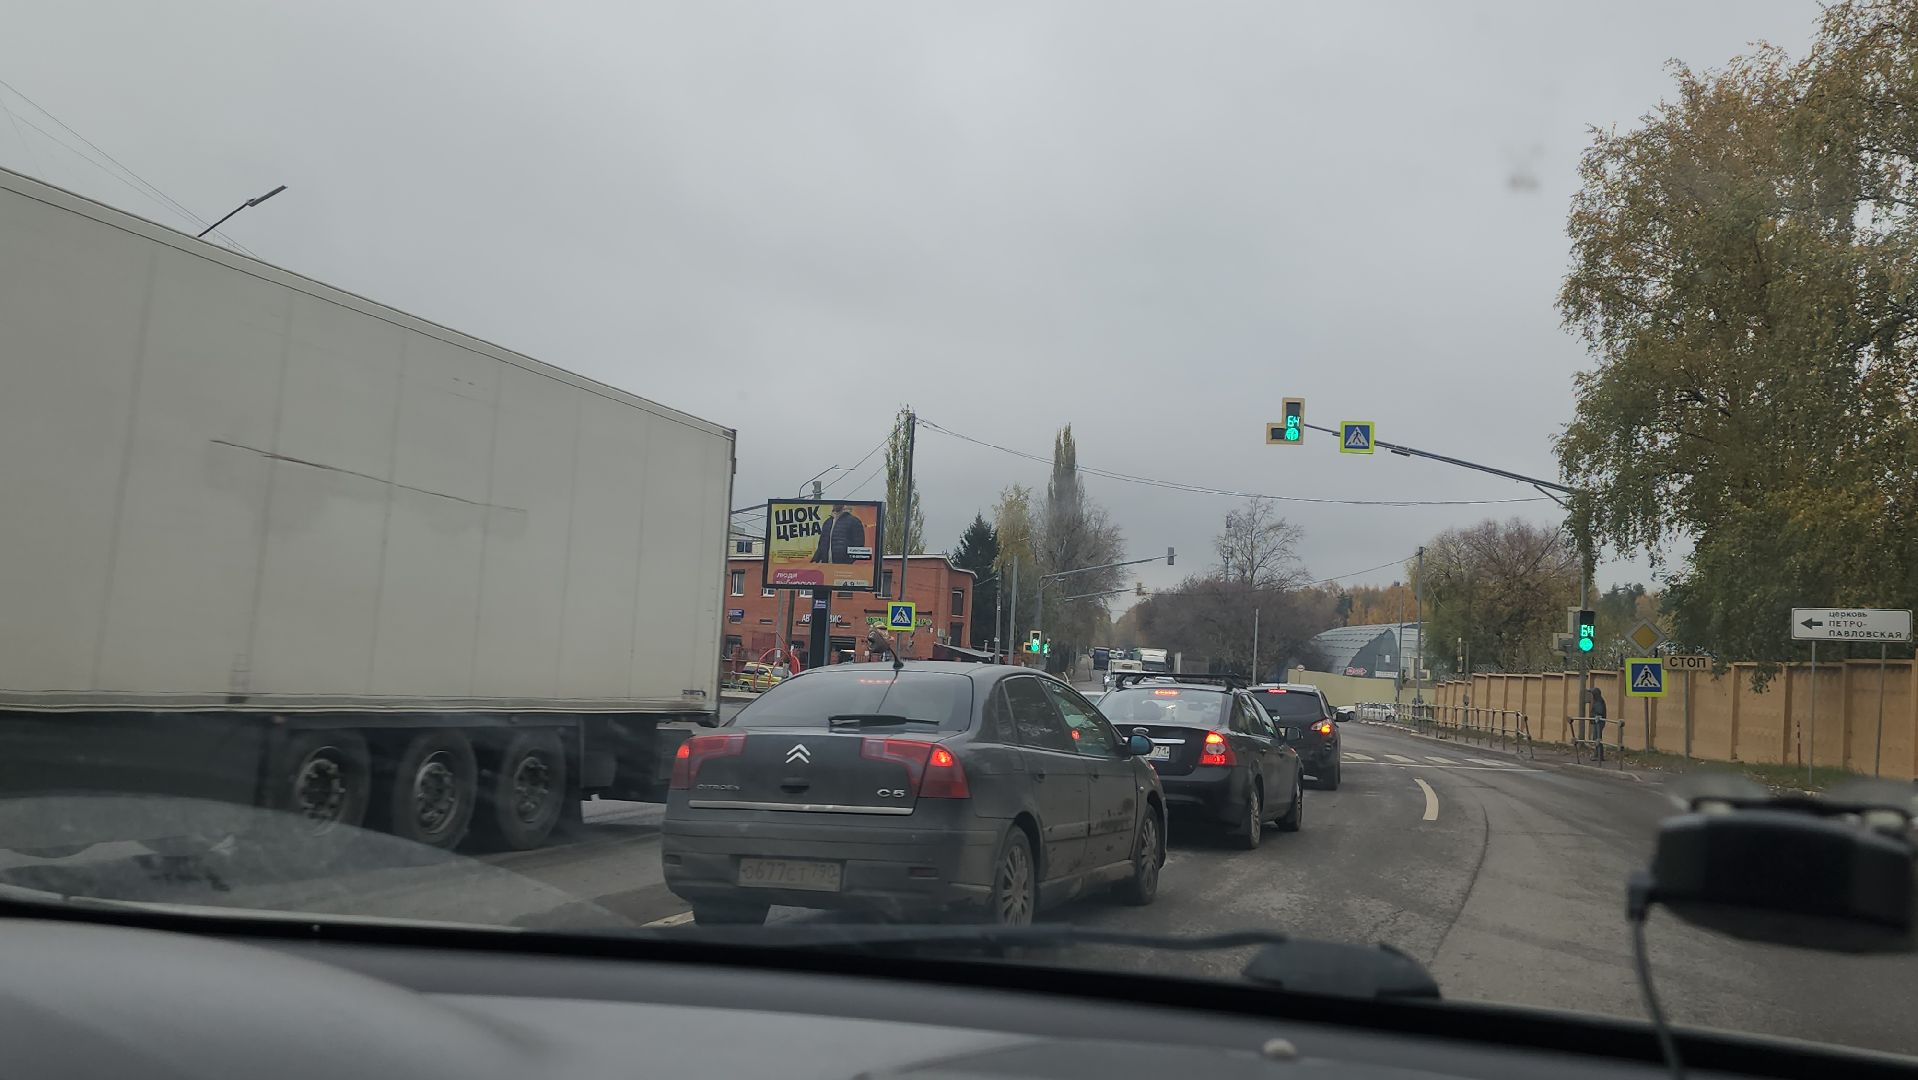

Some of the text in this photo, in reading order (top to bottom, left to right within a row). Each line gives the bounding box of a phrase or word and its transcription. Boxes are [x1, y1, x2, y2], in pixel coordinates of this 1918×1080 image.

[1287, 415, 1300, 427] 64
[775, 506, 821, 525] ШОК
[776, 522, 822, 541] ЦЕНА
[1581, 624, 1594, 637] 64
[1828, 630, 1902, 639] ПАВЛОВСКАЯ
[1669, 656, 1706, 668] СТОП
[876, 788, 905, 798] C5
